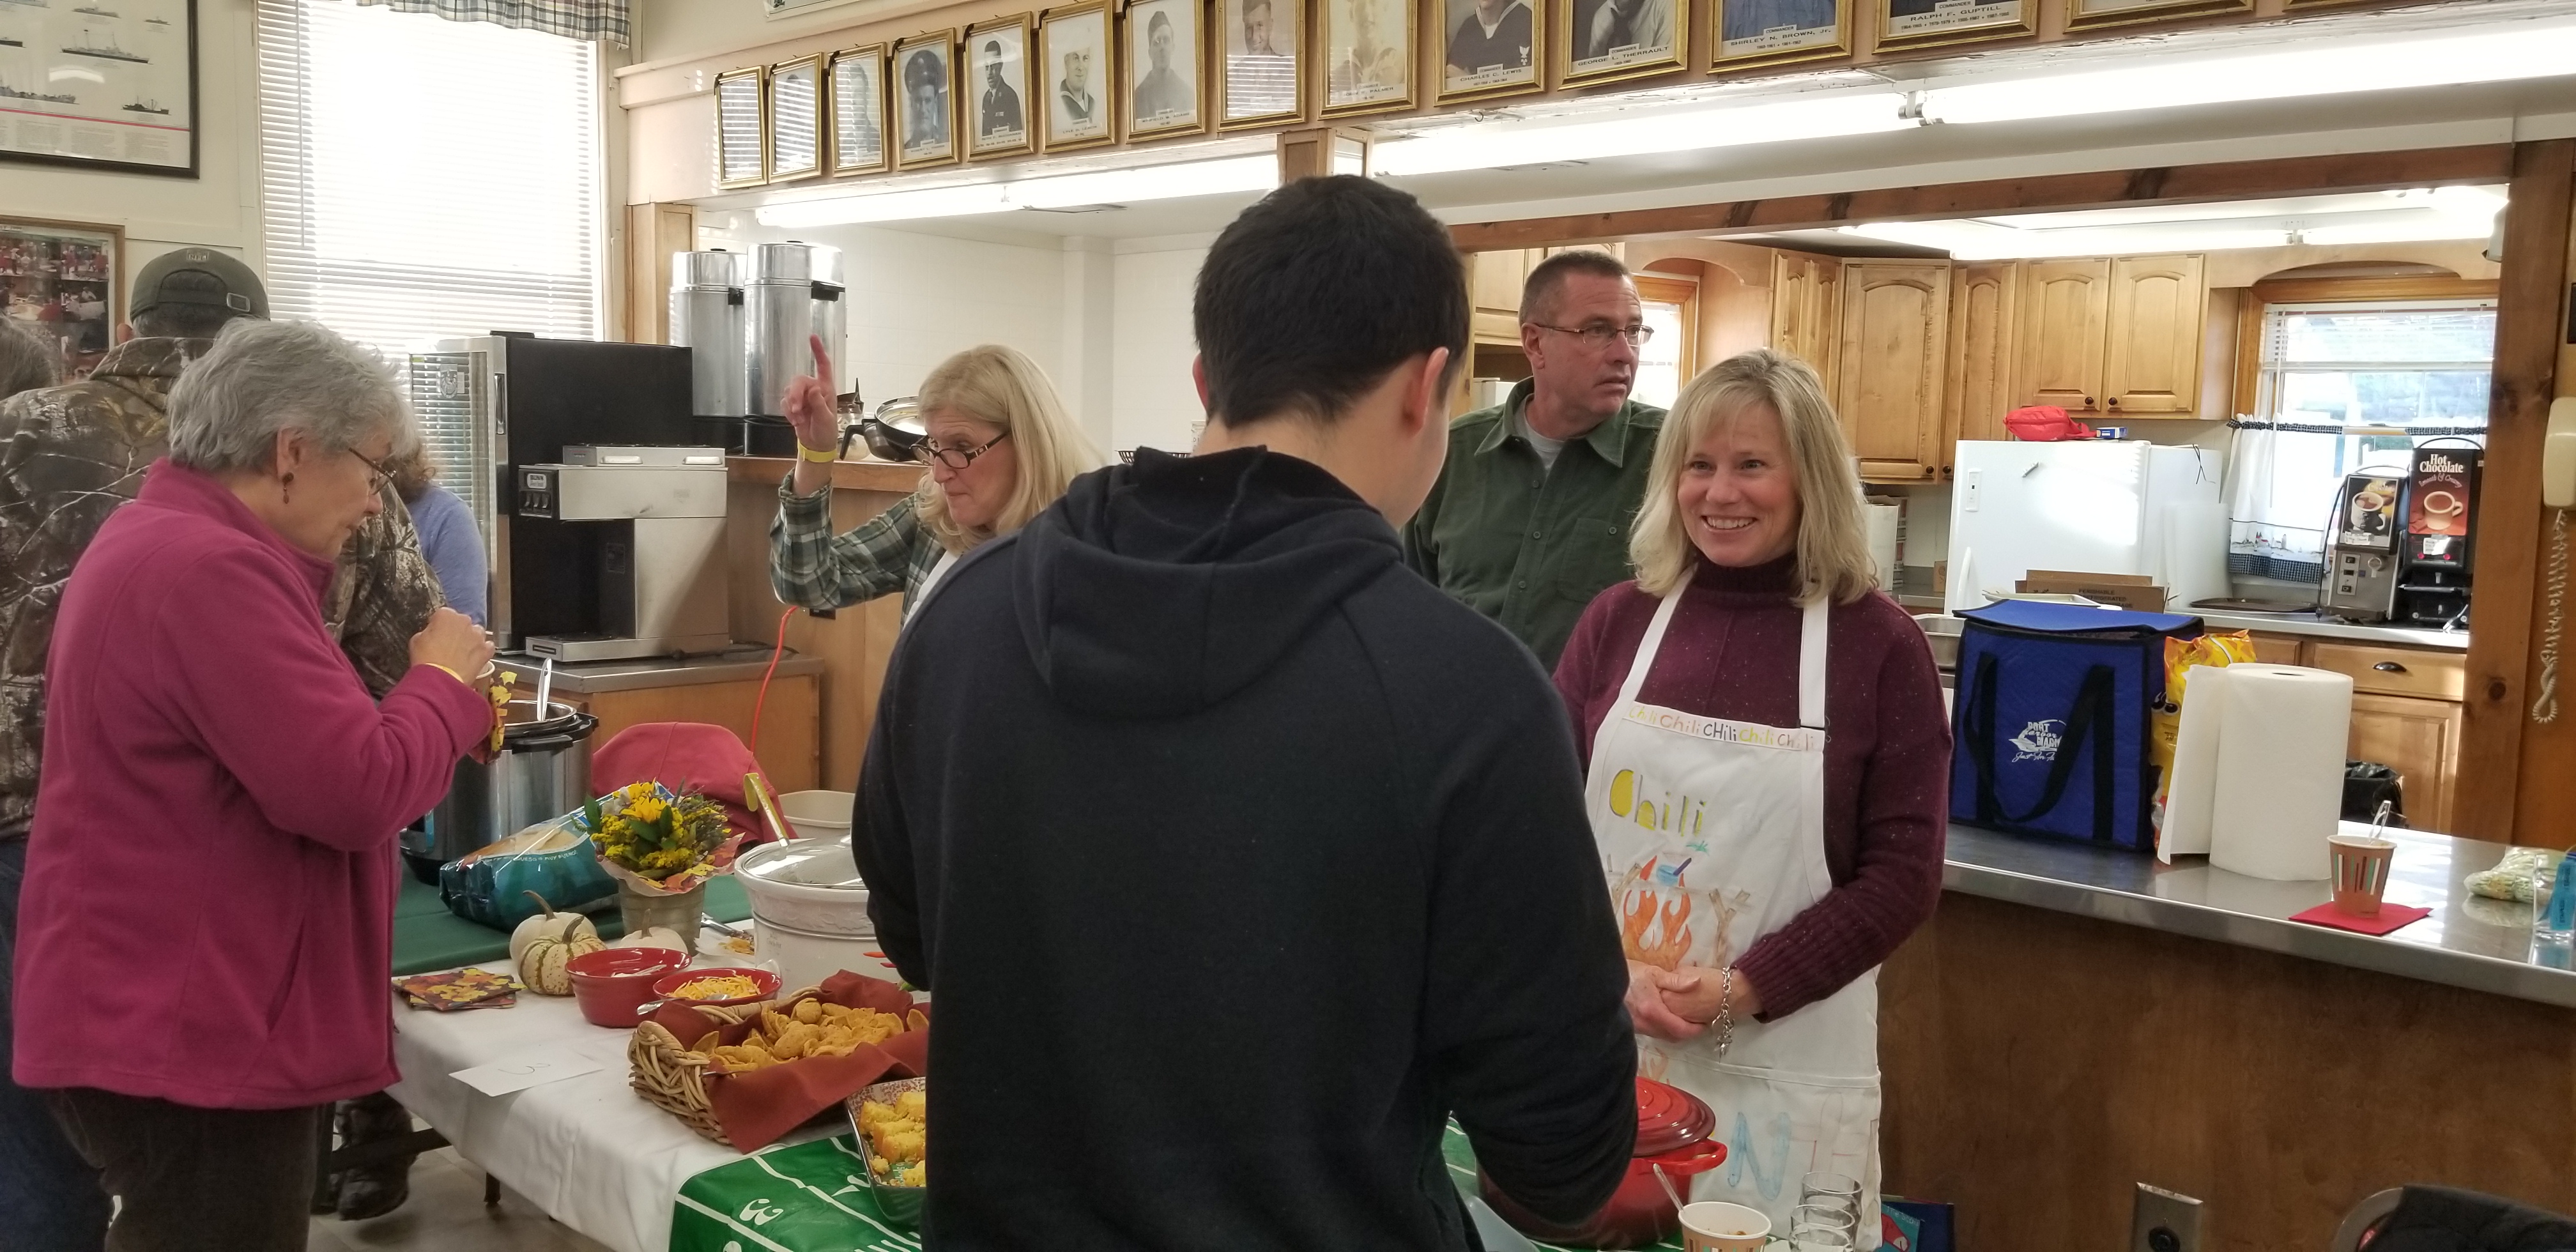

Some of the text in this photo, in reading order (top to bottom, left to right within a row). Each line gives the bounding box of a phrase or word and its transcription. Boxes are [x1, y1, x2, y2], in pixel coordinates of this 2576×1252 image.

[1910, 13, 1942, 22] RALPH
[1960, 5, 2002, 15] GUPTILL
[1731, 37, 1765, 46] SHIRLEY
[1578, 57, 1609, 66] GEORGE
[1623, 46, 1669, 58] THERRAULT
[1460, 73, 1490, 82] CHARLES
[2430, 454, 2448, 465] Hot
[2419, 461, 2464, 473] Chocolate
[1660, 714, 1700, 735] Chili
[1609, 768, 1706, 837] Chili
